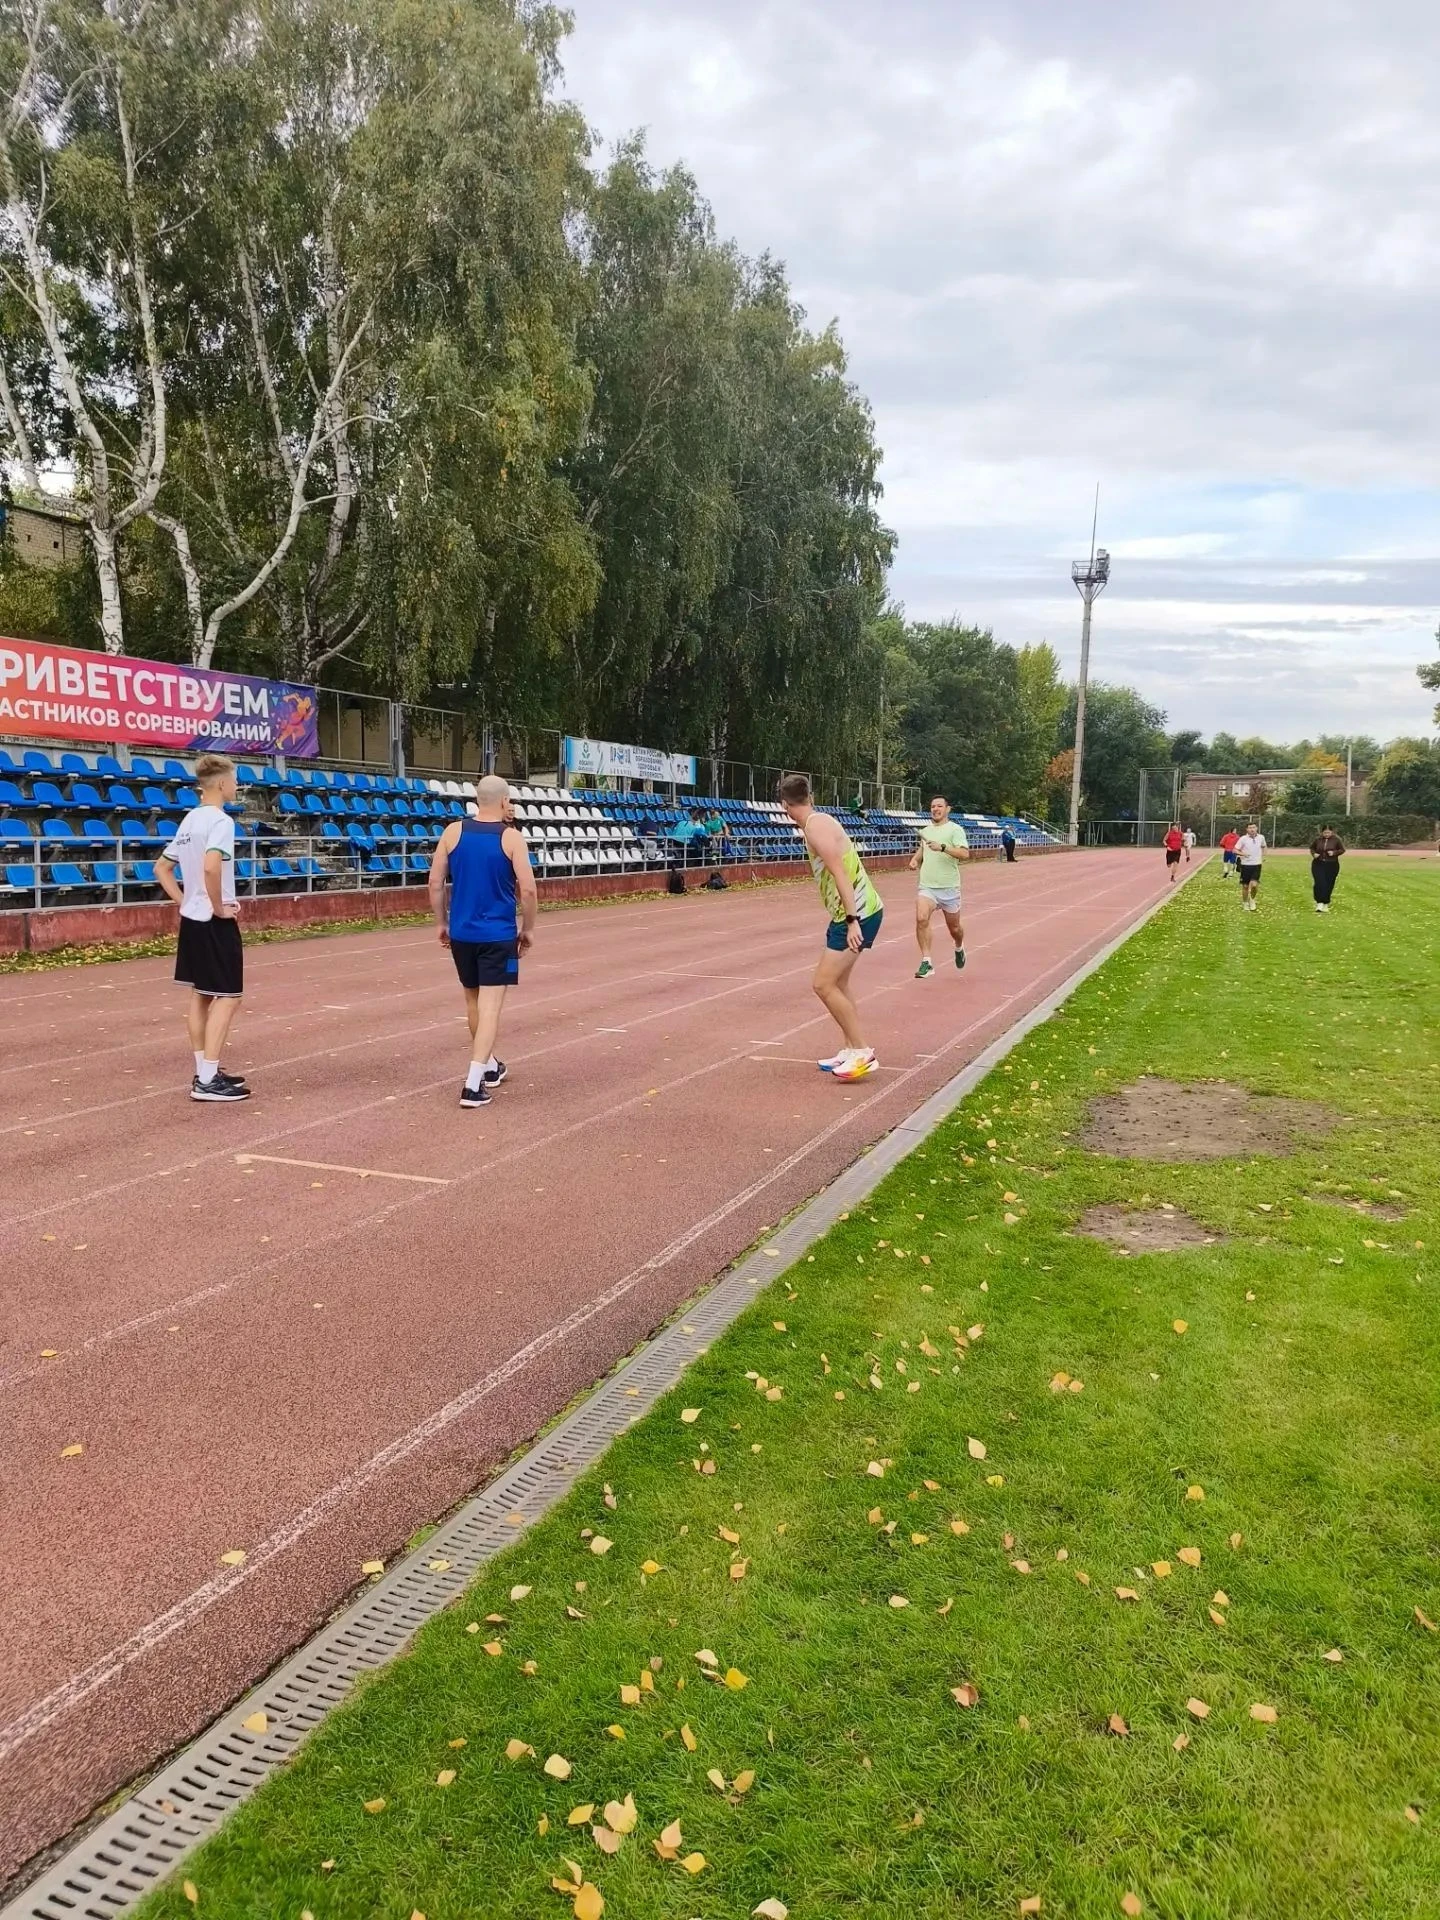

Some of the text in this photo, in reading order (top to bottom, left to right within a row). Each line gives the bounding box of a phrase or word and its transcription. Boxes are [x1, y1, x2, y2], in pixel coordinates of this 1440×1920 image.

[0, 649, 270, 718] РИВЕТСТВУЕМ
[0, 697, 272, 742] АСТНИКОВ СОРЕВНОВАНИЙ
